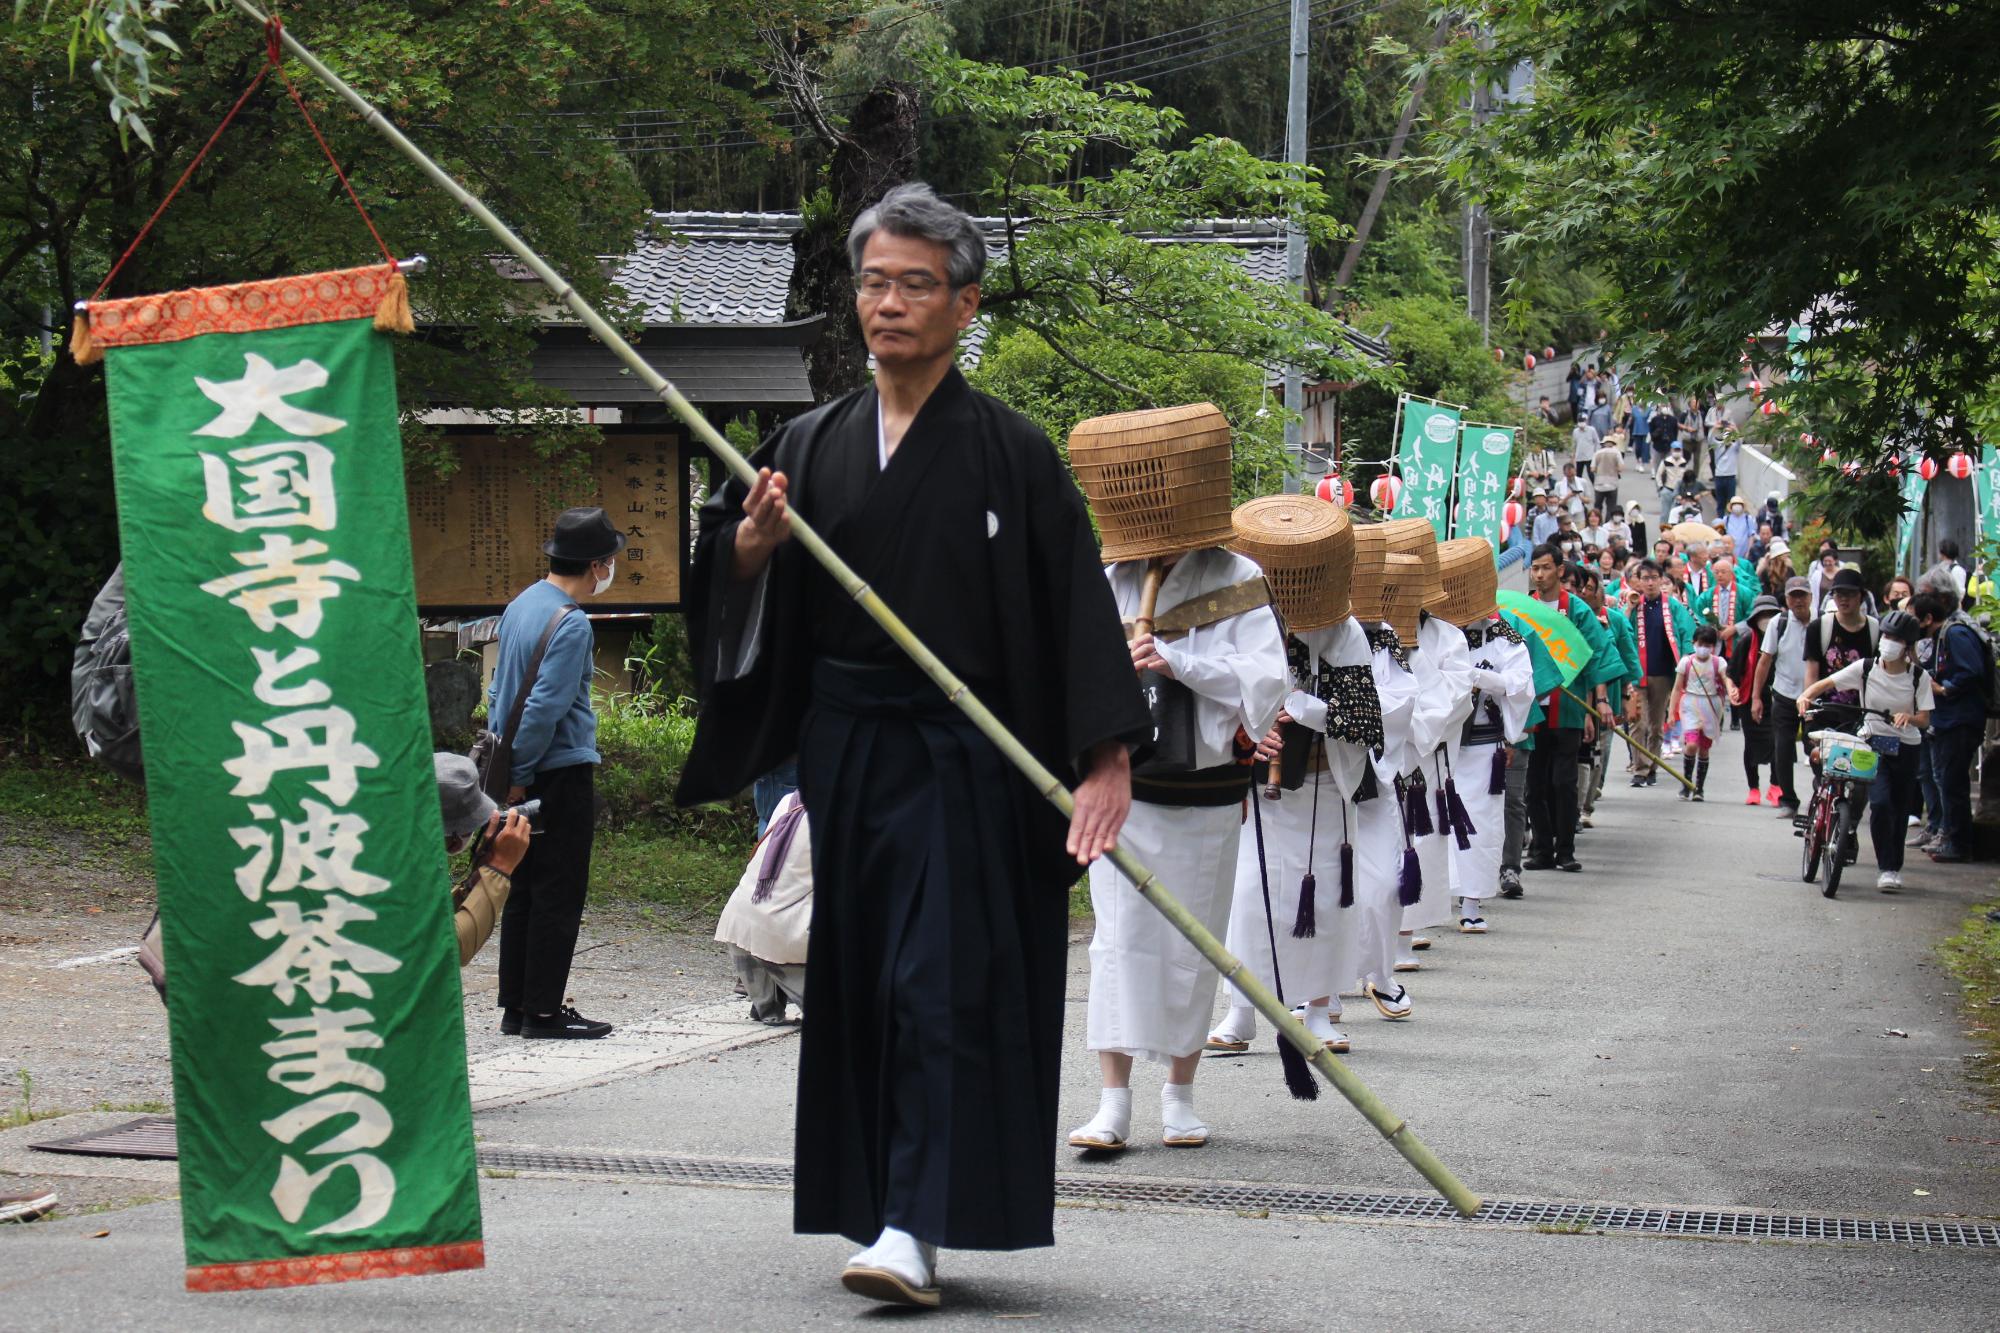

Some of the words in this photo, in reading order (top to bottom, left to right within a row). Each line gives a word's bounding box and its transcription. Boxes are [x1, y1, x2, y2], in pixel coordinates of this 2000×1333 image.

[191, 352, 403, 1235] 大国寺と丹波茶まつり
